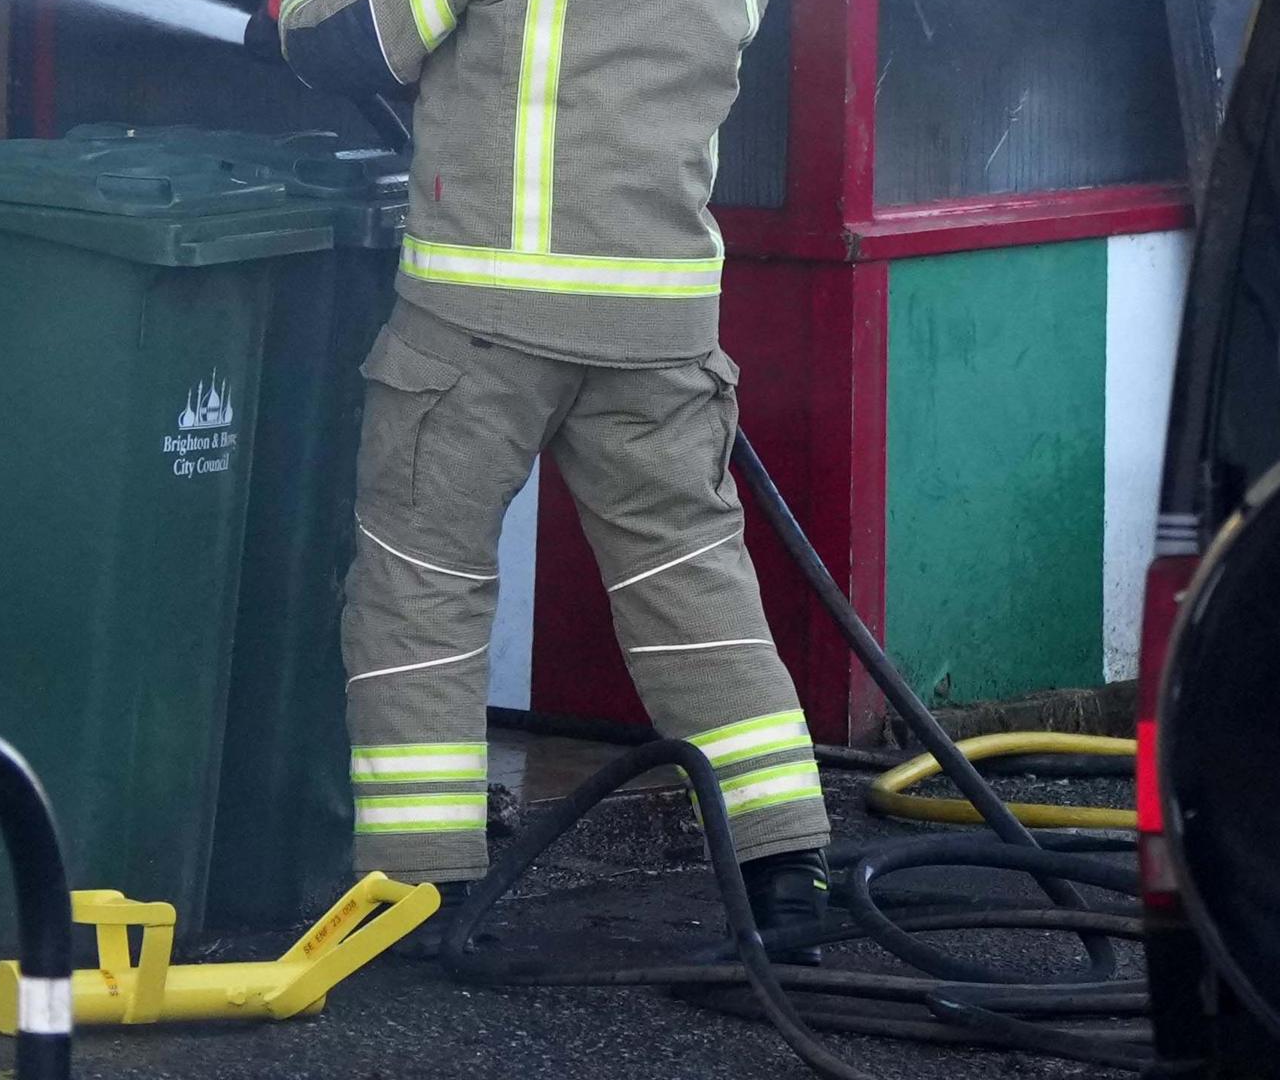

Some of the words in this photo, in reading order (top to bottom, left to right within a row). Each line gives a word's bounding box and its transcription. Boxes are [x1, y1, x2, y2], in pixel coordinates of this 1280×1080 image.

[163, 434, 210, 456] Brighton
[211, 432, 219, 449] &
[173, 458, 196, 479] City
[197, 453, 230, 474] Council
